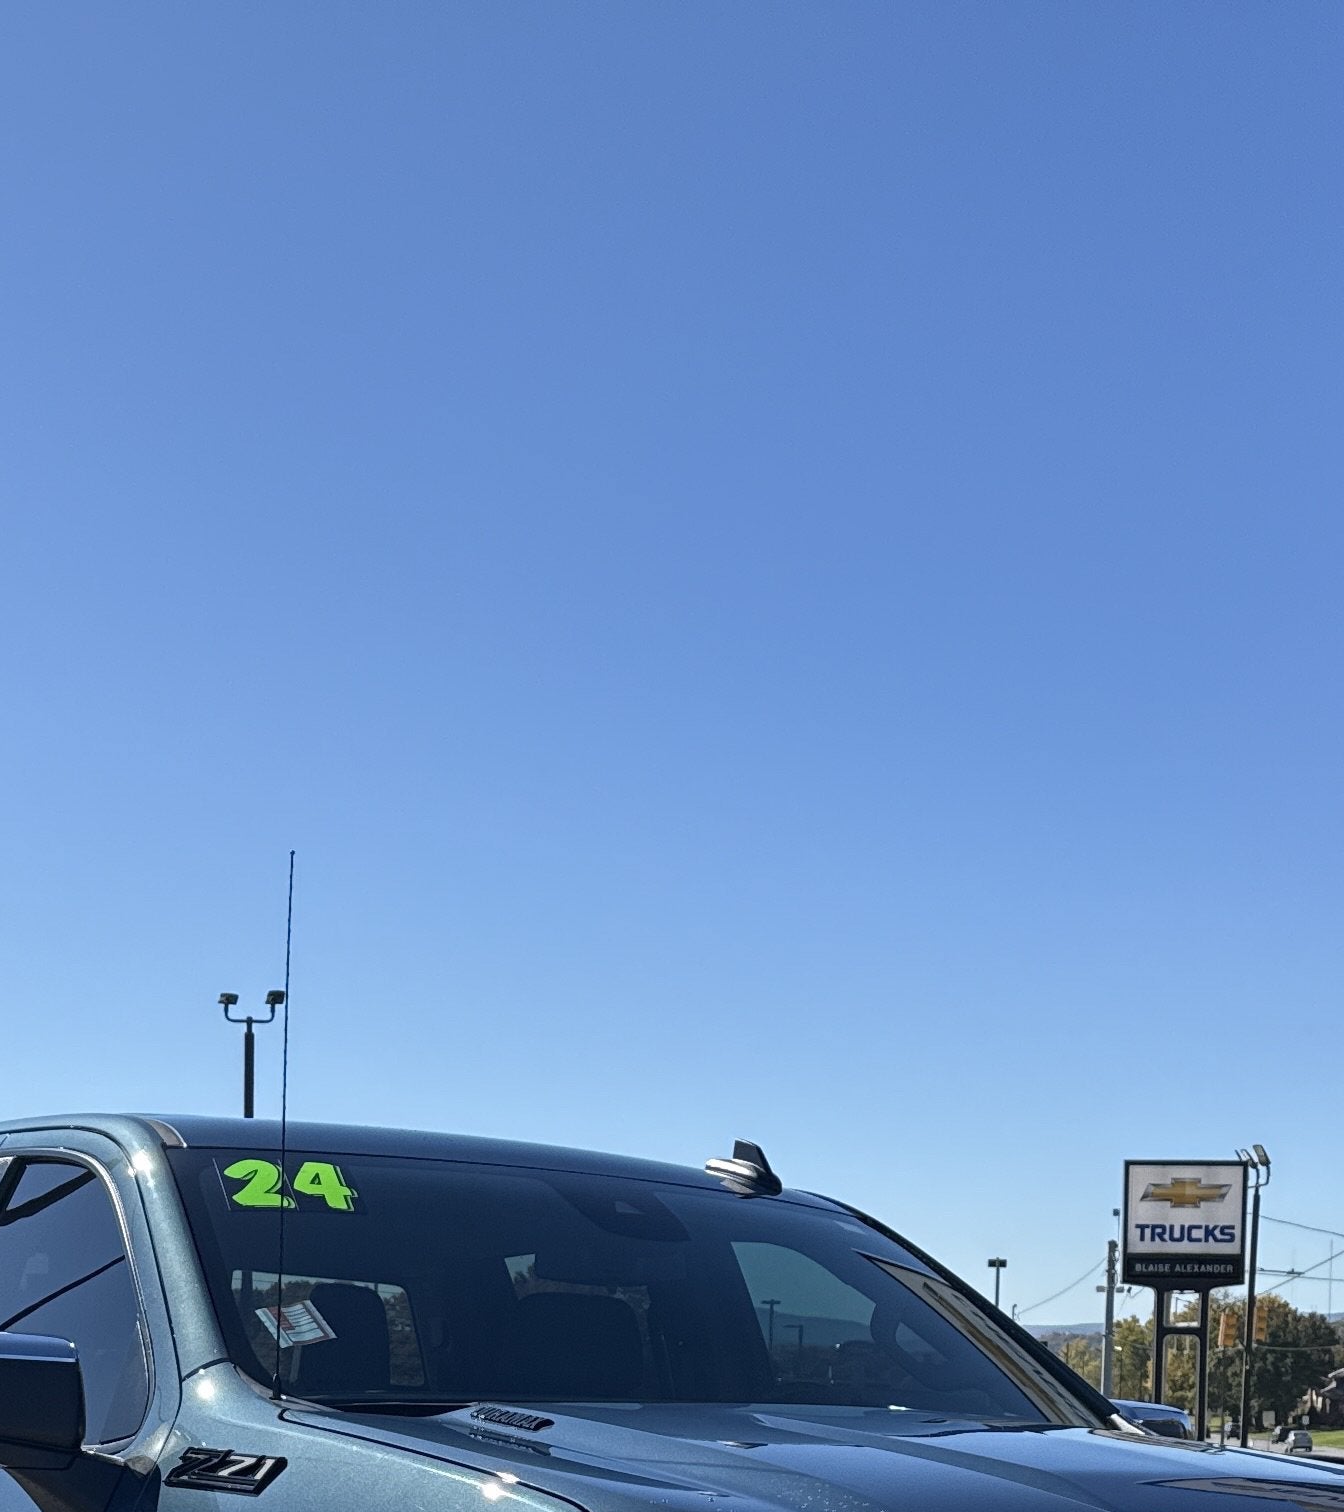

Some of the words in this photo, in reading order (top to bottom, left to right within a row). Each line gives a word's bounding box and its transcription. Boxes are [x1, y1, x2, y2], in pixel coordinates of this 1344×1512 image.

[223, 1158, 359, 1211] 24
[1135, 1224, 1236, 1243] TRUCKS
[1135, 1263, 1171, 1272] BLAISE
[1174, 1263, 1234, 1273] ALEXANDER
[164, 1447, 287, 1497] Z71
